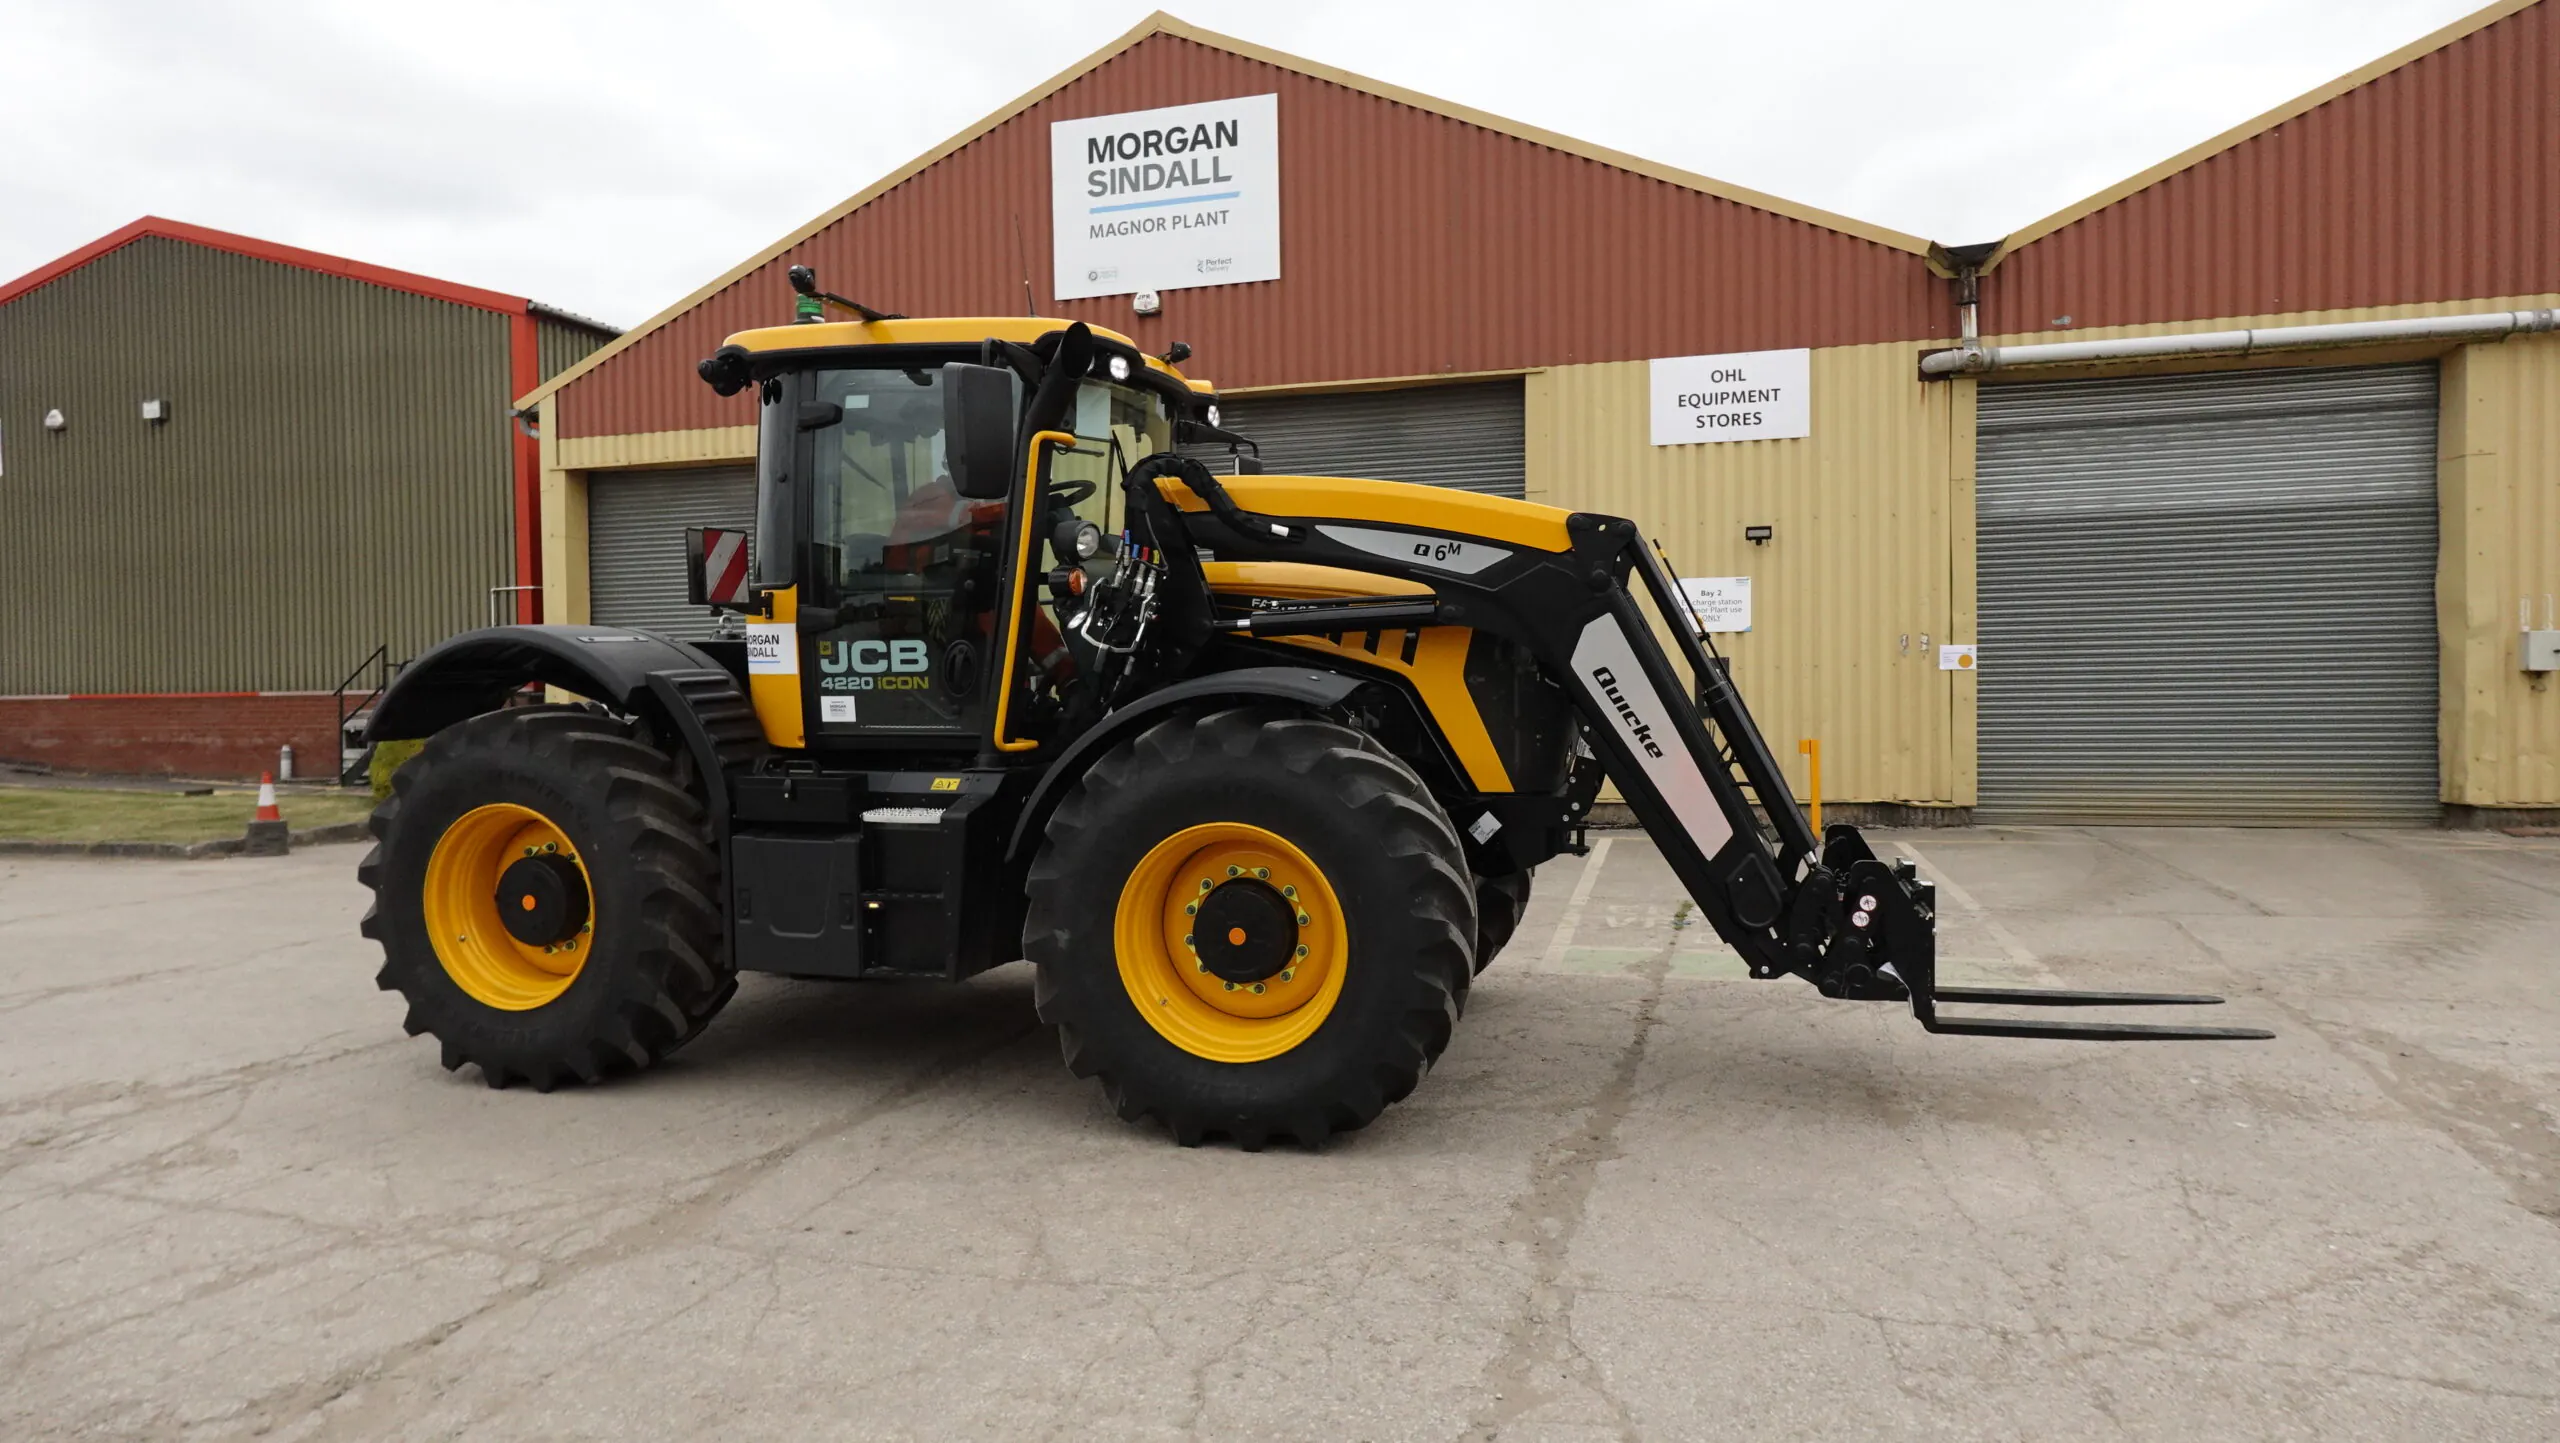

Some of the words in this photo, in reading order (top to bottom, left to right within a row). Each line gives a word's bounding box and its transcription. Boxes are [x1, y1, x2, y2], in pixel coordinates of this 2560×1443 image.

[1088, 119, 1239, 165] MORGAN
[1087, 155, 1233, 197] SINDALL
[1090, 216, 1167, 239] MAGNOR
[1172, 209, 1230, 229] PLANT
[1710, 369, 1746, 383] OHL
[1678, 388, 1781, 409] EQUIPMENT
[1696, 411, 1762, 429] STORES
[1692, 599, 1716, 607] charge
[1700, 589, 1714, 598] Bay
[820, 639, 929, 673] JCB
[820, 676, 874, 690] 4220
[877, 676, 929, 690] iCON
[1592, 666, 1664, 759] Quicke
